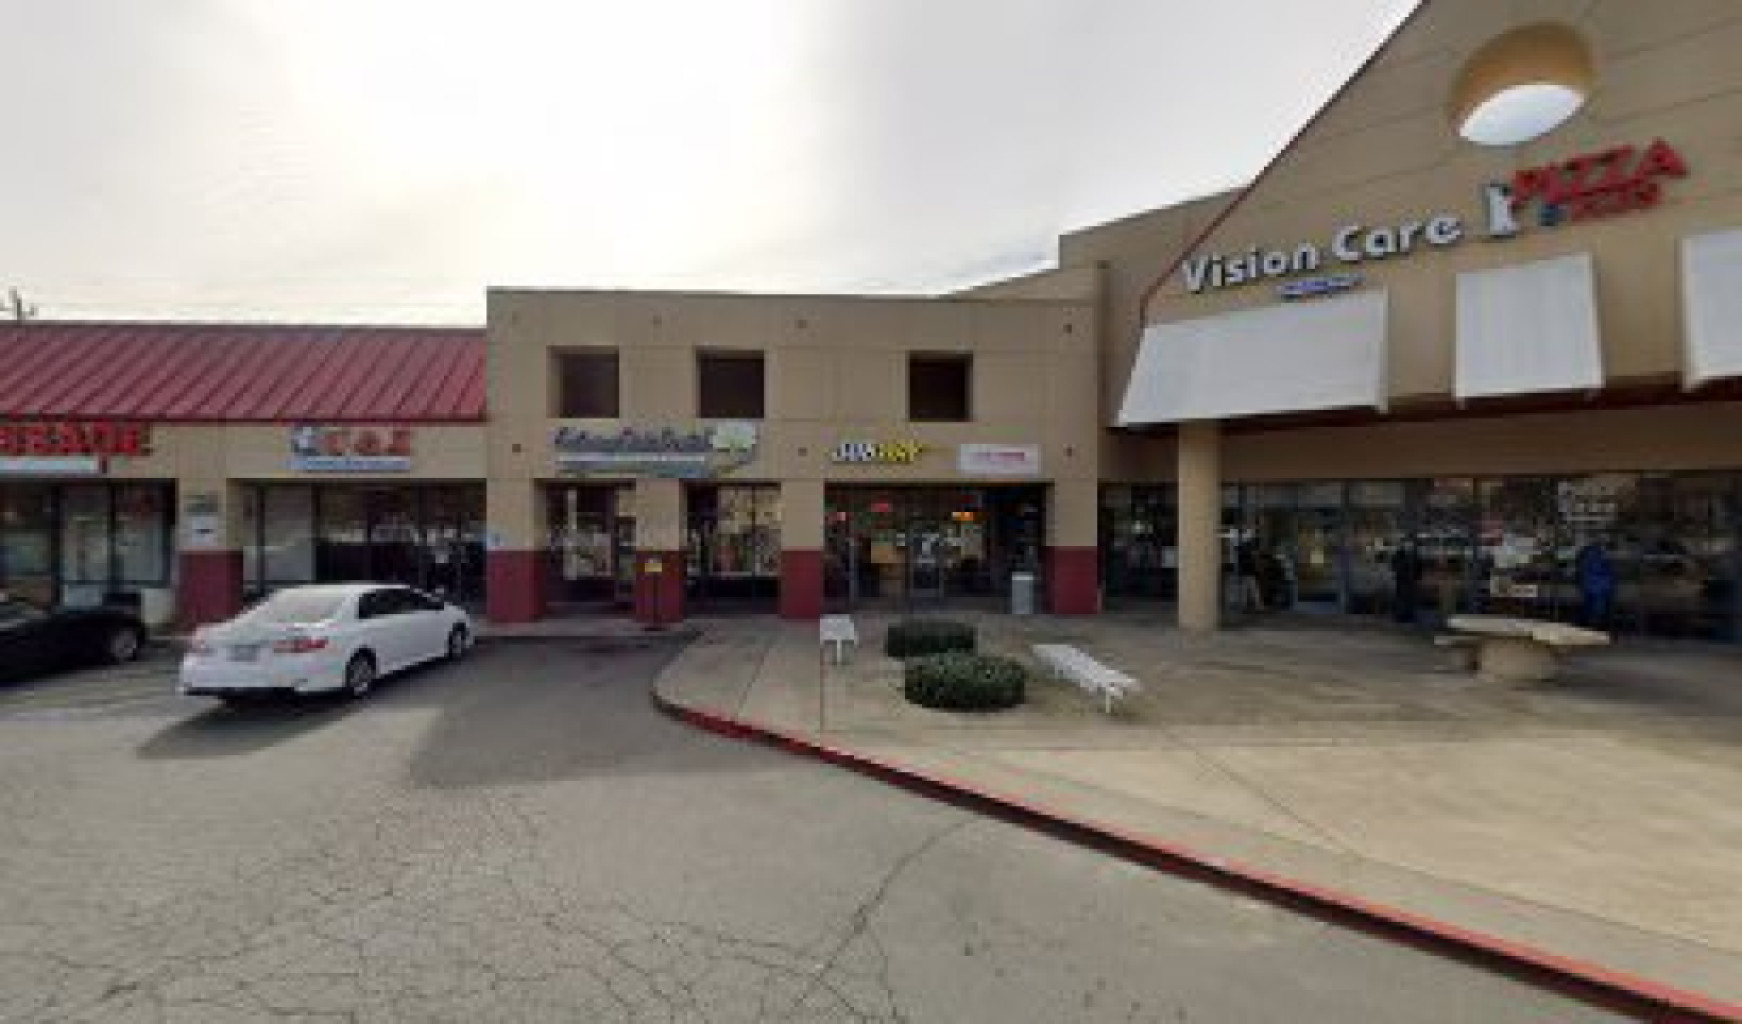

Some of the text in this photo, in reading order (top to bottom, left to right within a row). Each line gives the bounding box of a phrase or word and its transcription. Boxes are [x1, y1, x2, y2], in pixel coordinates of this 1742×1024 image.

[1509, 137, 1689, 208] PIZZA
[1182, 243, 1321, 294] Vision
[1331, 216, 1463, 263] Care
